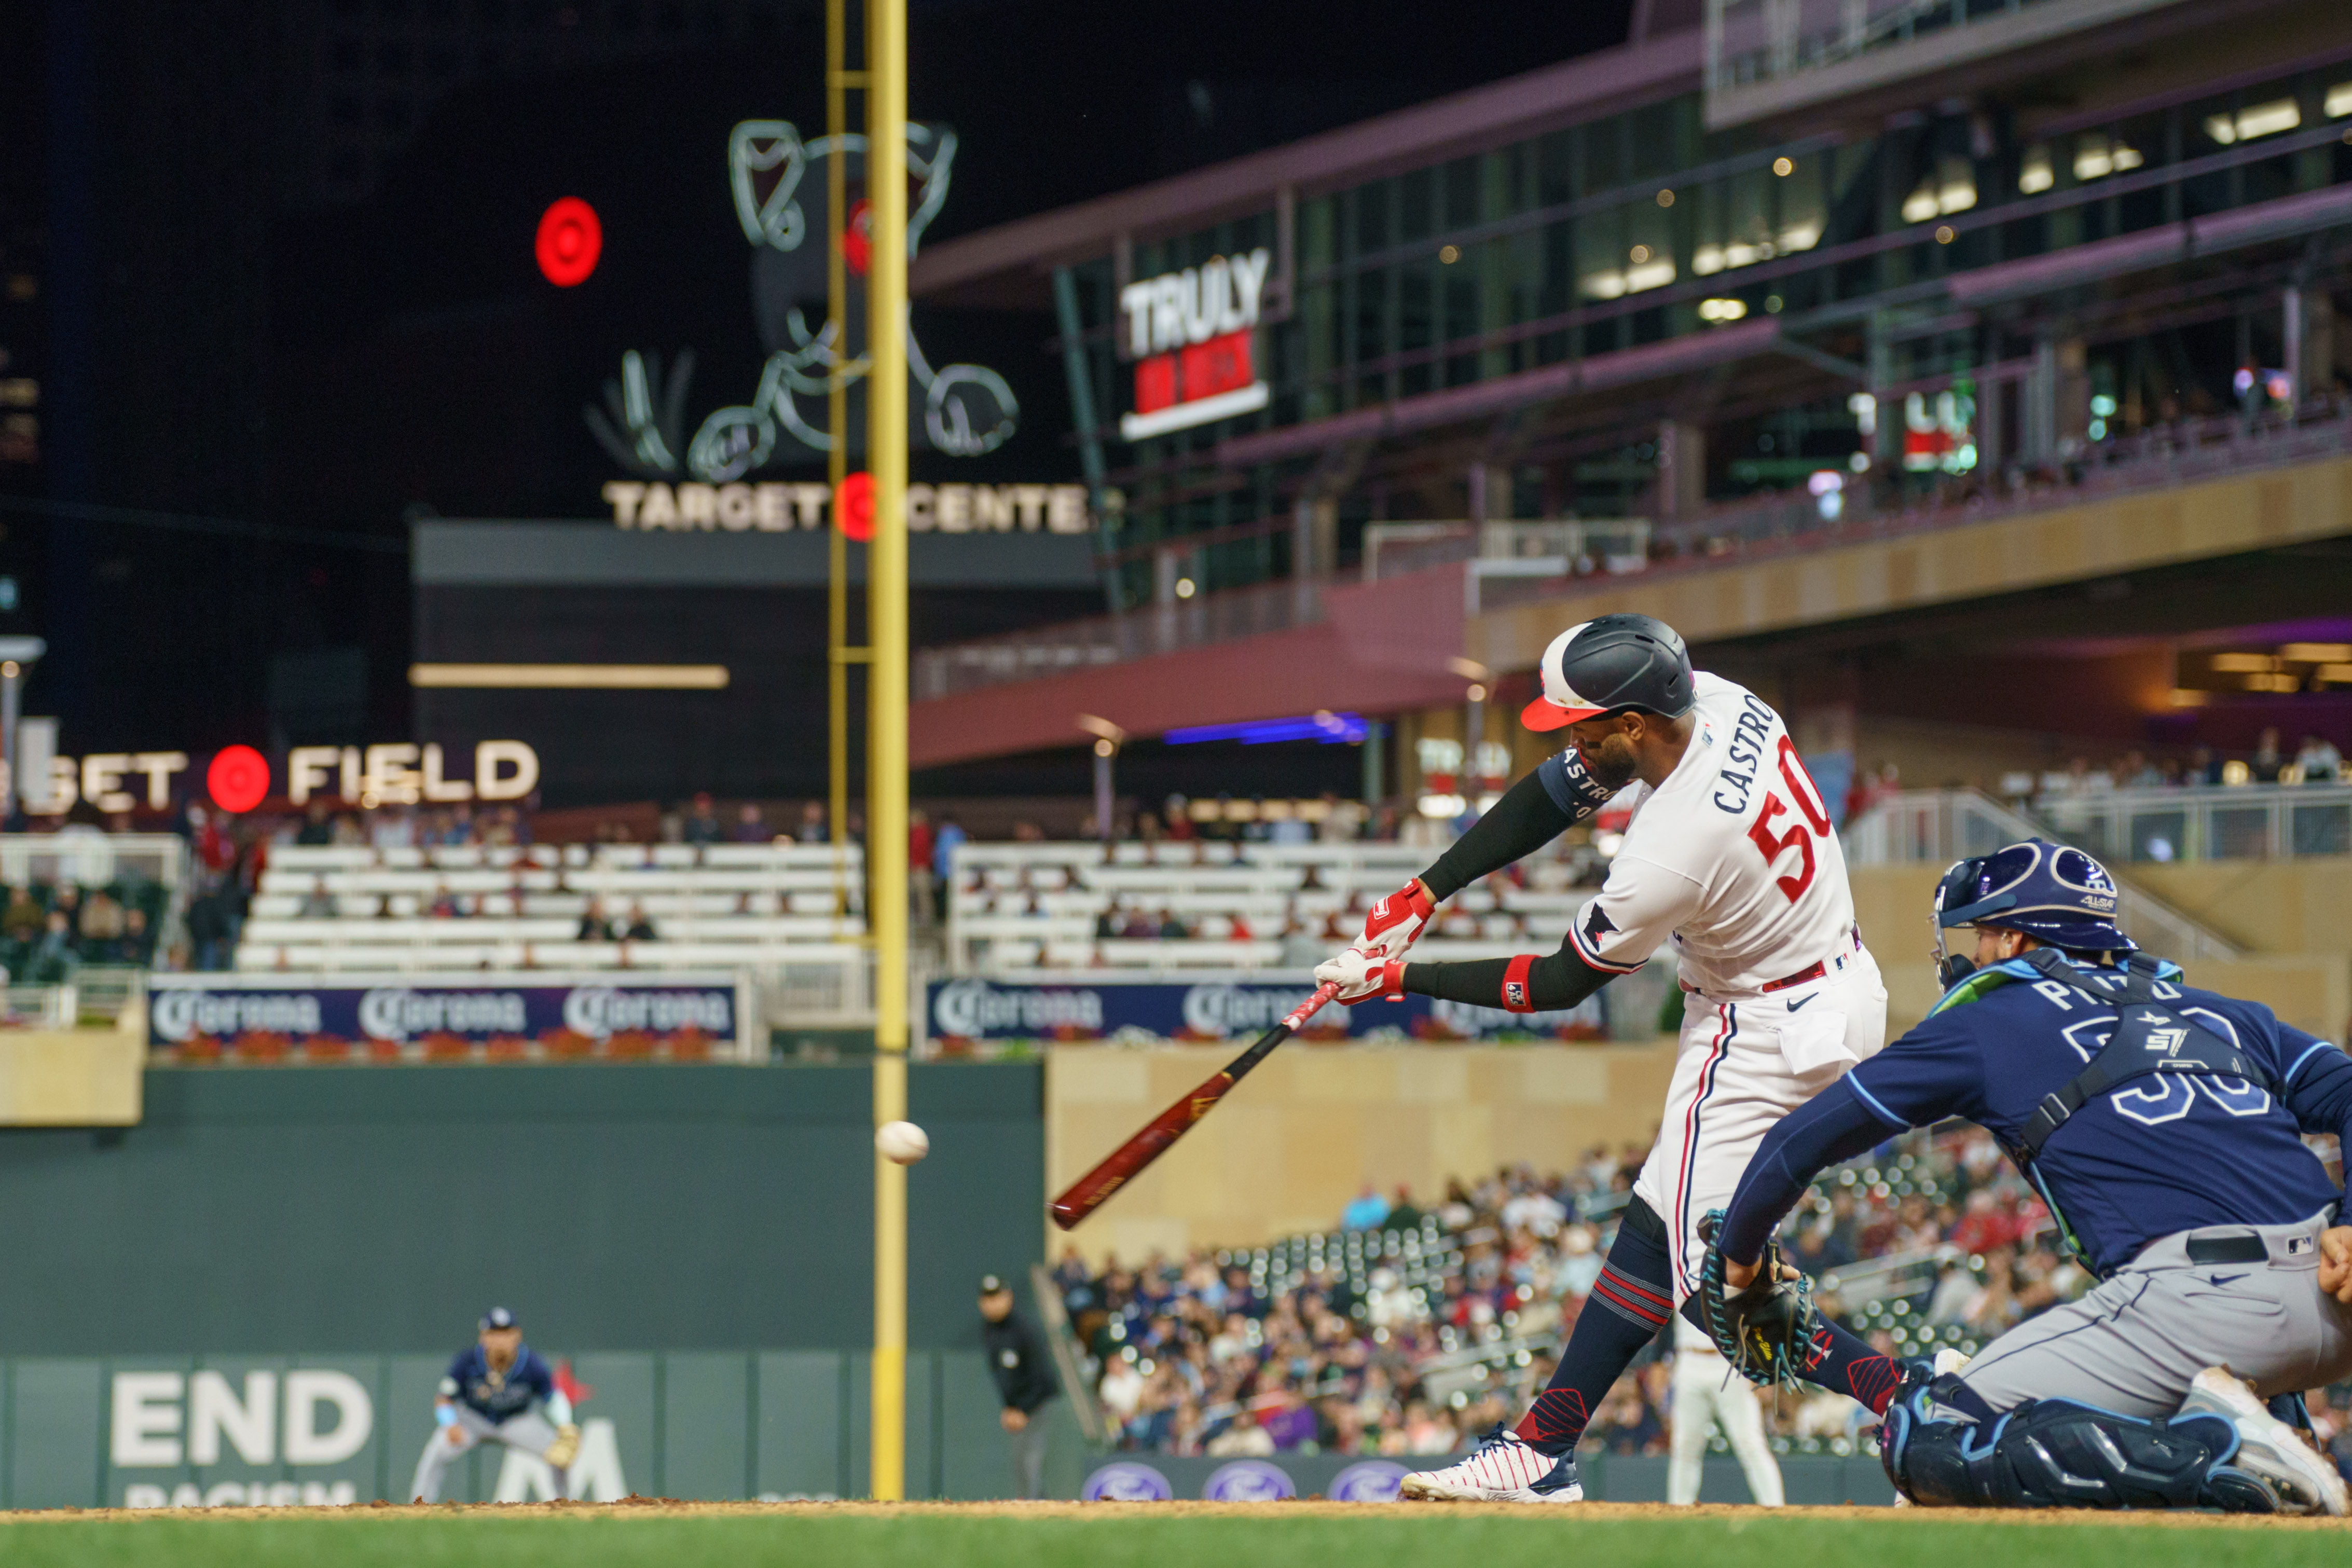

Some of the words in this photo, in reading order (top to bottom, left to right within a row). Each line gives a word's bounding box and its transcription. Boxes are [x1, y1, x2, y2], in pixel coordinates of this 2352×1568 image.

[1121, 246, 1270, 358] TRULY
[603, 482, 830, 530] TARGET
[906, 483, 1090, 534] CENTE
[288, 739, 540, 807] FIELD
[1564, 744, 1620, 800] ASTRO
[1714, 694, 1773, 814] CASTRO
[1746, 734, 1831, 904] 50
[111, 1370, 374, 1467] END
